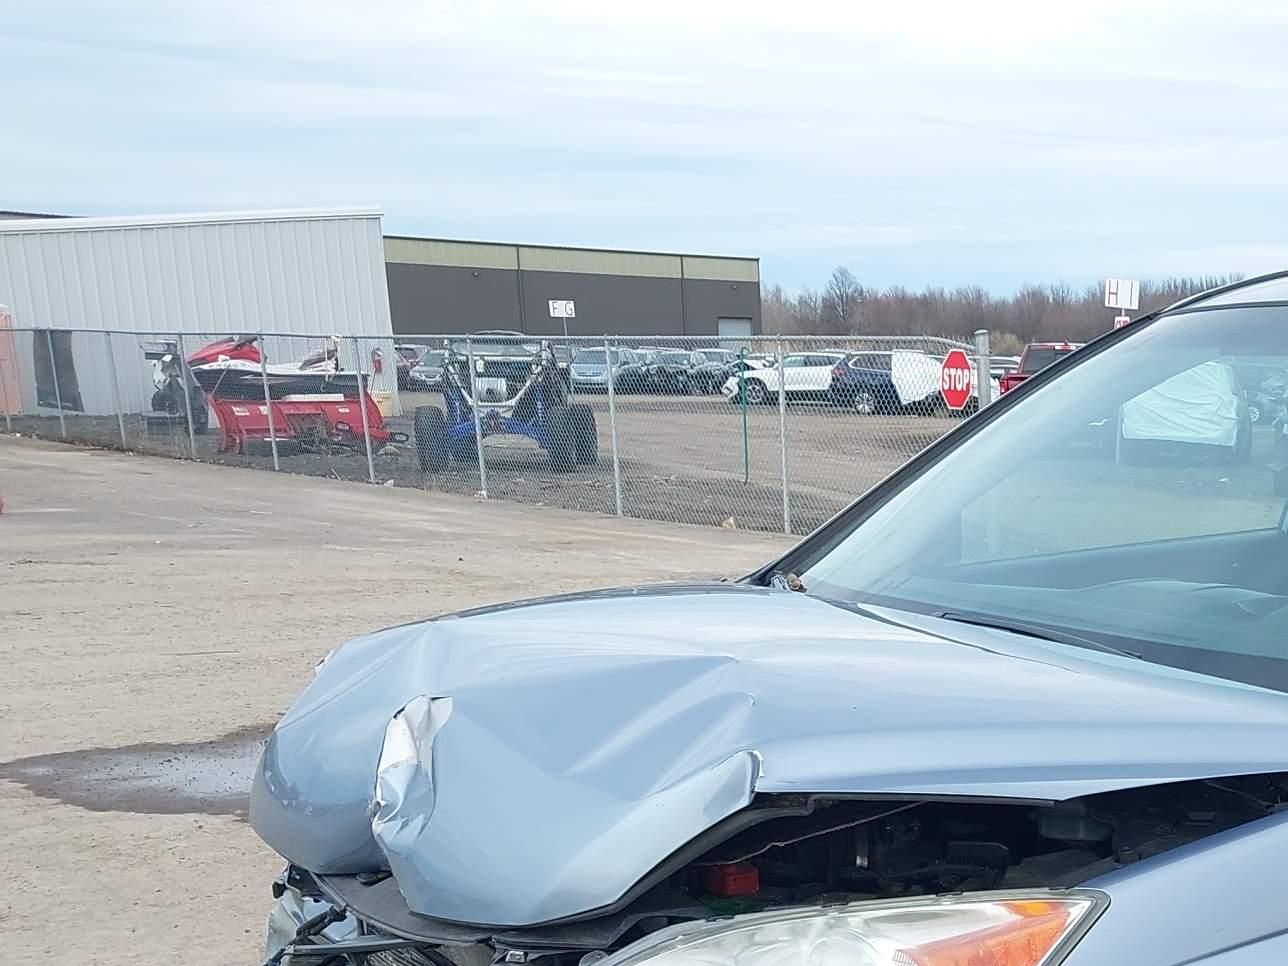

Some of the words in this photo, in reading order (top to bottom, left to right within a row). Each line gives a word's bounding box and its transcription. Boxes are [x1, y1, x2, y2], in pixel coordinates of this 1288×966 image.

[1107, 279, 1119, 306] H
[551, 301, 558, 316] F
[564, 301, 574, 317] G
[942, 367, 970, 392] STOP
